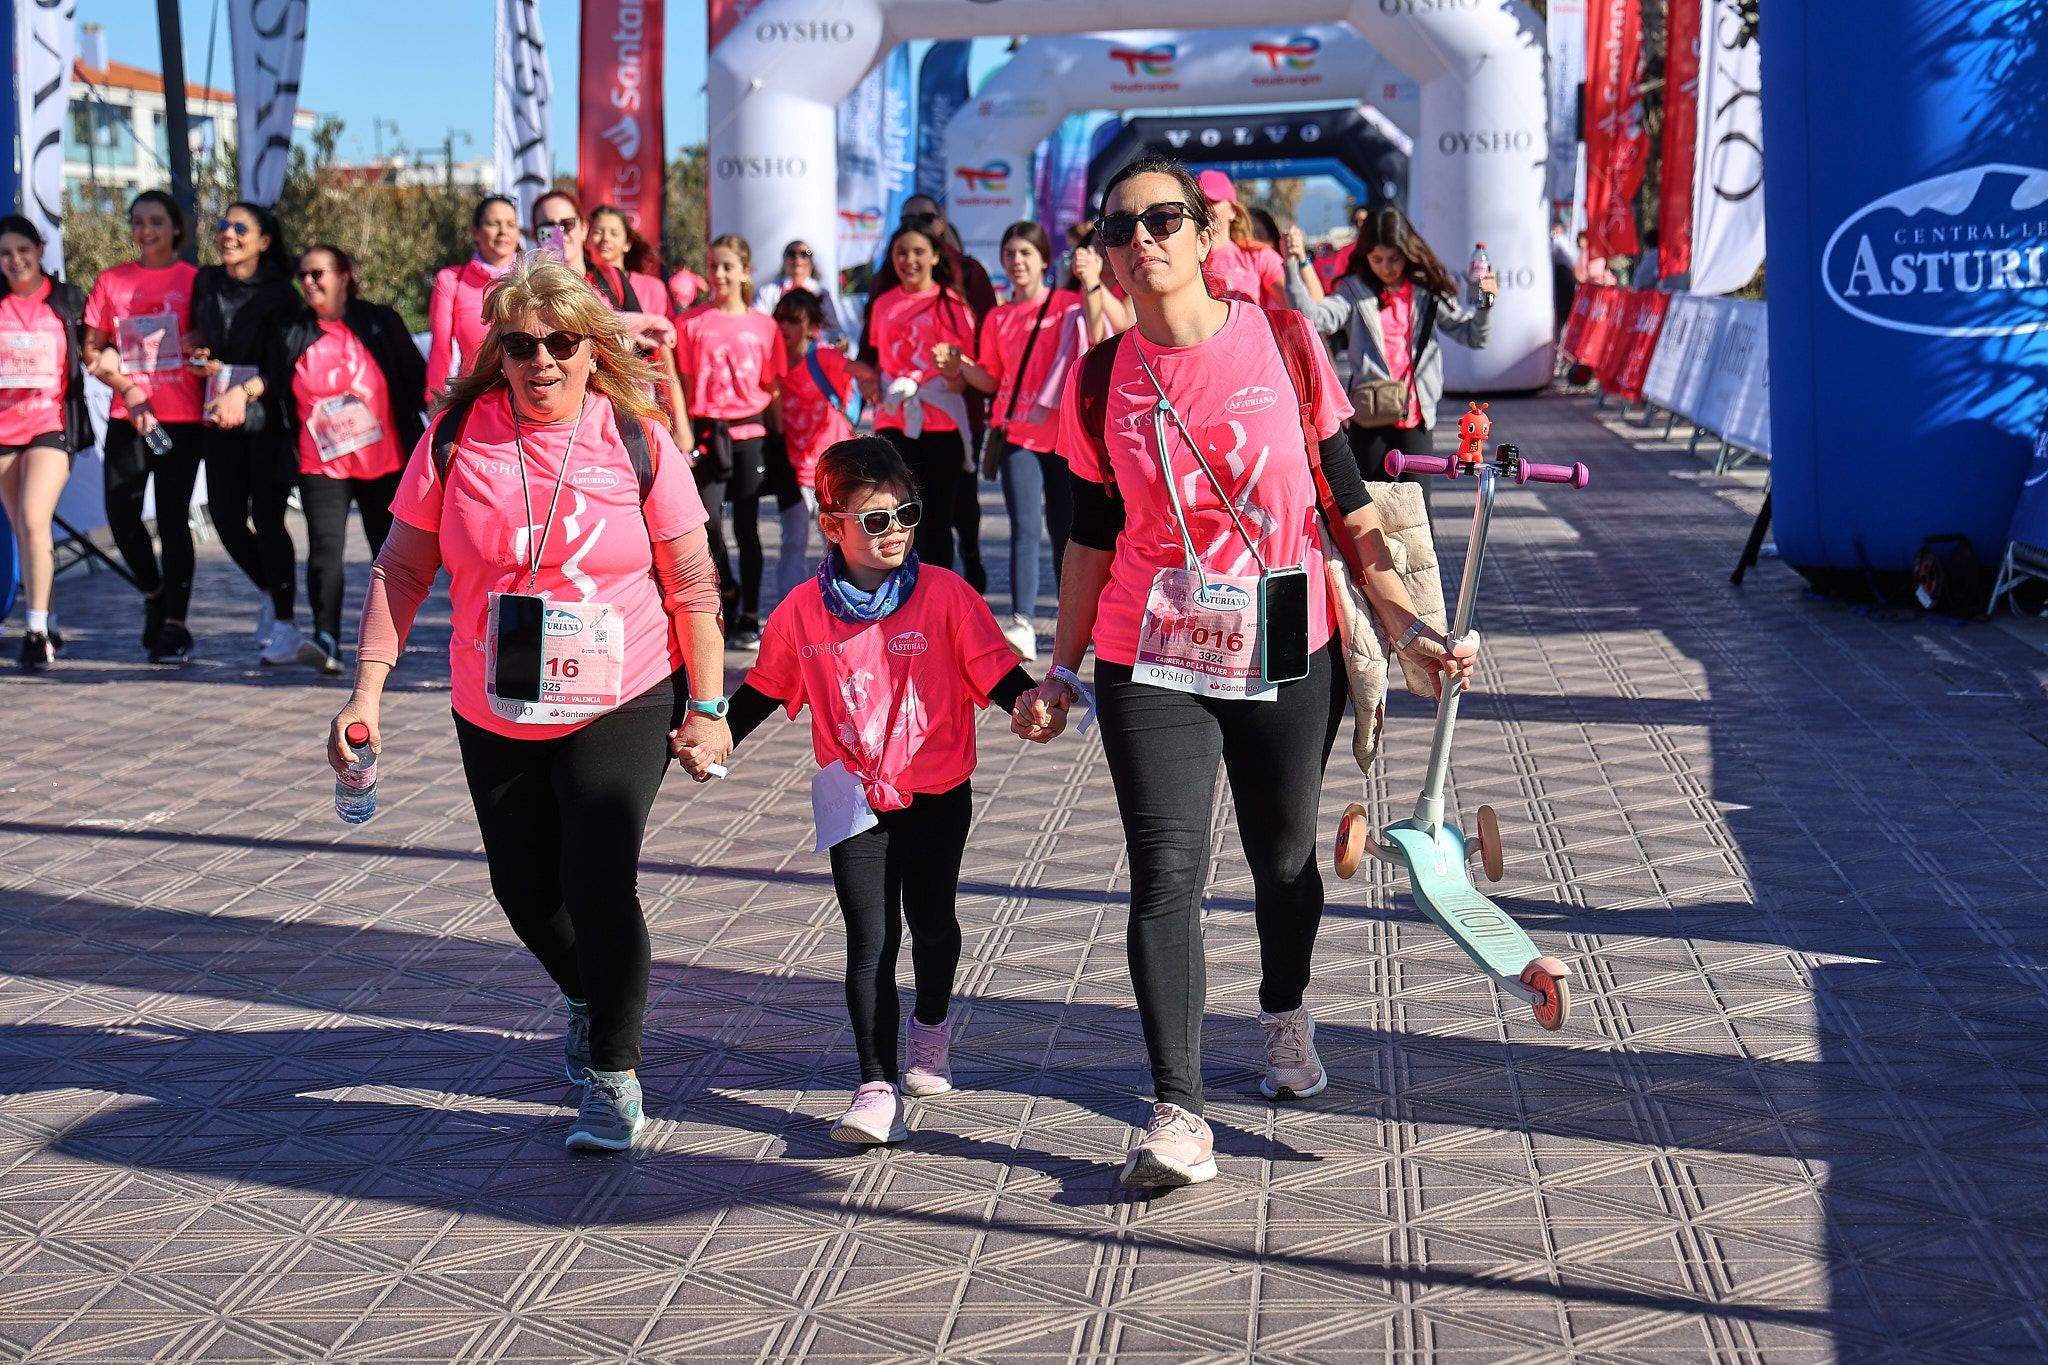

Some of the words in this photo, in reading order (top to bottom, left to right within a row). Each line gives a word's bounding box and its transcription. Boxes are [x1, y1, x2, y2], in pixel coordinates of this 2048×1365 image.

[756, 19, 854, 43] OYSHO
[1164, 125, 1322, 147] VOLVO
[1439, 131, 1532, 156] OYSHO
[717, 155, 807, 181] OYSHO
[1894, 222, 2011, 245] CENTRAL
[2022, 220, 2048, 238] LE
[1843, 234, 2048, 297] ASTURI
[801, 641, 843, 658] OYSHO
[1192, 628, 1244, 652] 016
[546, 657, 579, 678] 16
[1155, 656, 1185, 666] CARRERA
[1186, 661, 1195, 669] DE
[1196, 663, 1204, 671] LA
[1205, 665, 1227, 676] MUJER
[1198, 651, 1224, 664] 3924
[1150, 668, 1194, 685] OYSHO
[542, 682, 561, 692] 925
[1221, 683, 1260, 693] Santander
[496, 701, 534, 717] OYSHO
[560, 710, 601, 718] Santander
